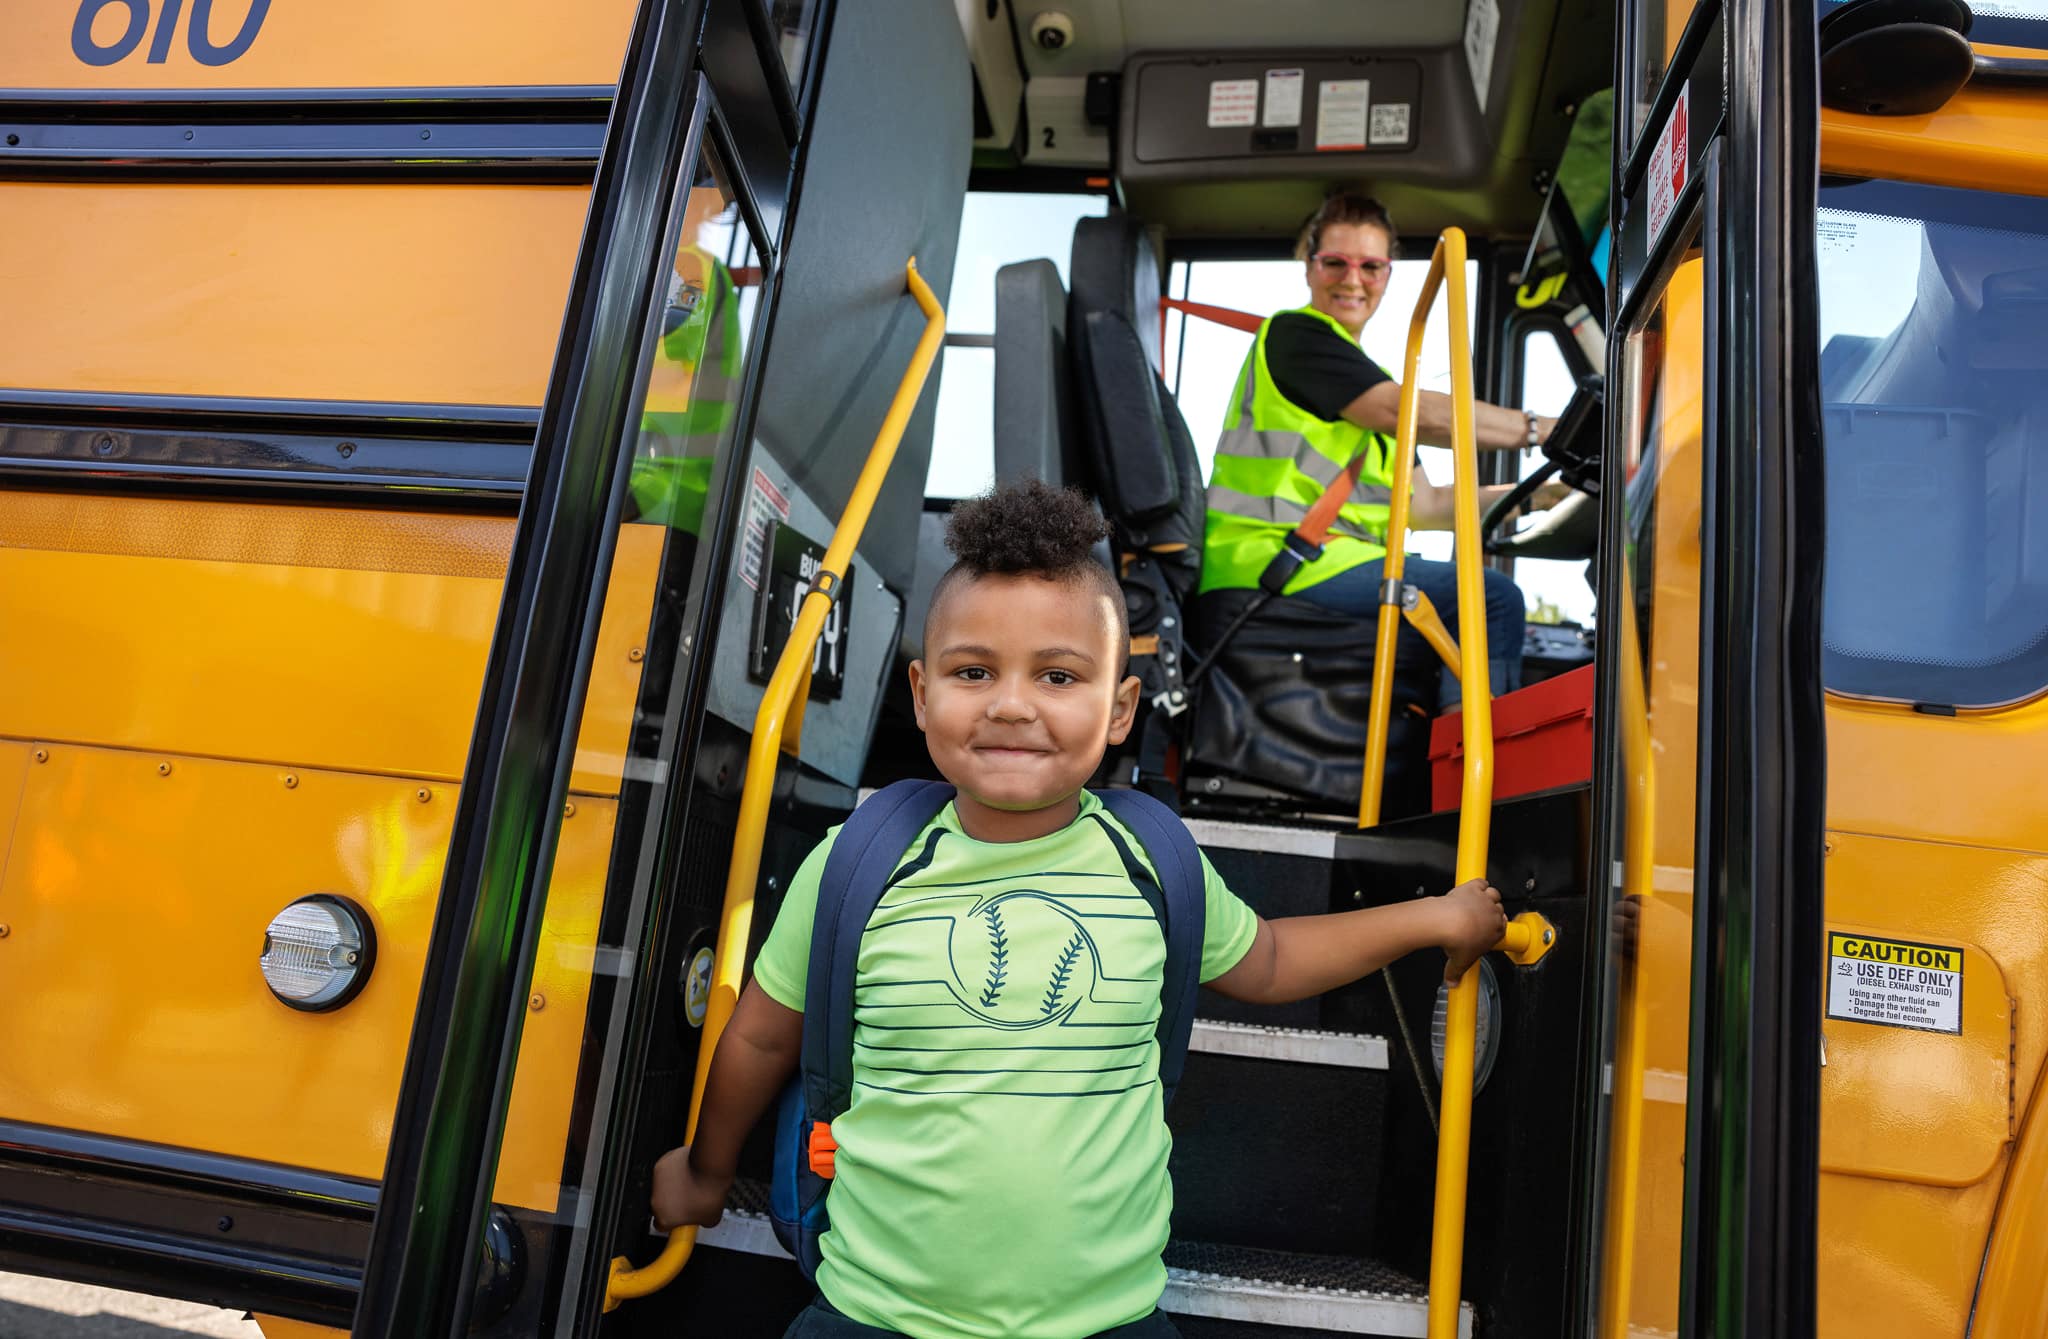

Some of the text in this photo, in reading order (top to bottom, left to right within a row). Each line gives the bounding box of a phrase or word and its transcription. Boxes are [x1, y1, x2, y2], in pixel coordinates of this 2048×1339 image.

[1043, 127, 1056, 149] 2
[1656, 159, 1665, 187] EXIT
[1651, 171, 1669, 217] ACTIVATE
[1651, 194, 1669, 238] RELEASE
[1843, 940, 1951, 970] CAUTION
[1856, 976, 1953, 998] (DIESEL EXHAUST FLUID)
[1857, 962, 1954, 988] USE DEF ONLY
[1849, 988, 1940, 1008] Using any other fluid can
[1854, 998, 1927, 1015] Damage the vehicle
[1853, 1006, 1937, 1025] Degrade fuel economy
